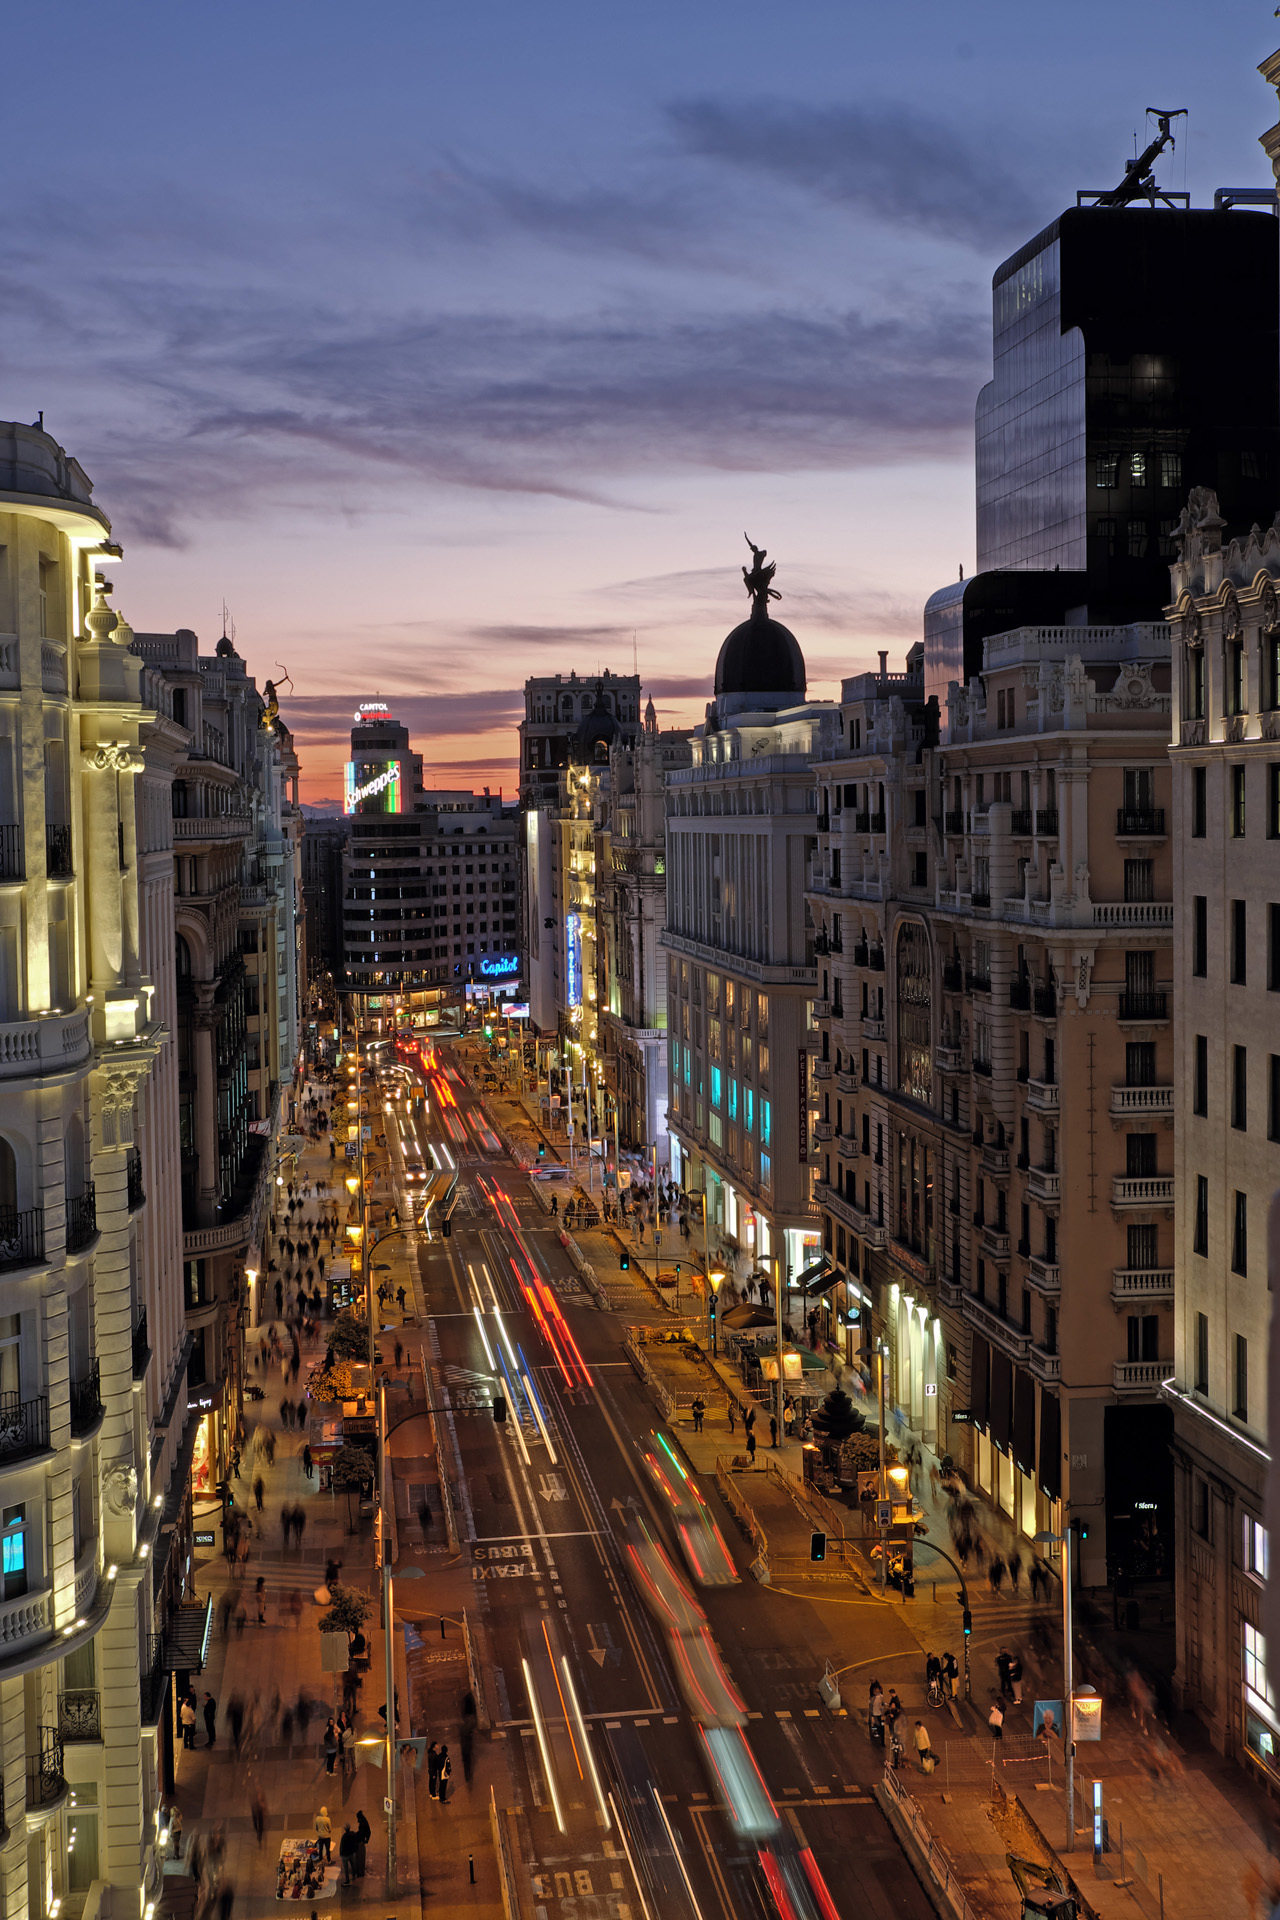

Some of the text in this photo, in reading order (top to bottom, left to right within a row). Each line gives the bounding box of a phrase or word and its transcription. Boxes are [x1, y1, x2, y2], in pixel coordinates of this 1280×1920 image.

[359, 703, 389, 711] CAPITOL
[347, 764, 401, 810] Schweppes
[481, 956, 519, 977] Capitol
[568, 950, 576, 1005] ATLANTICO
[534, 1869, 595, 1900] BUS
